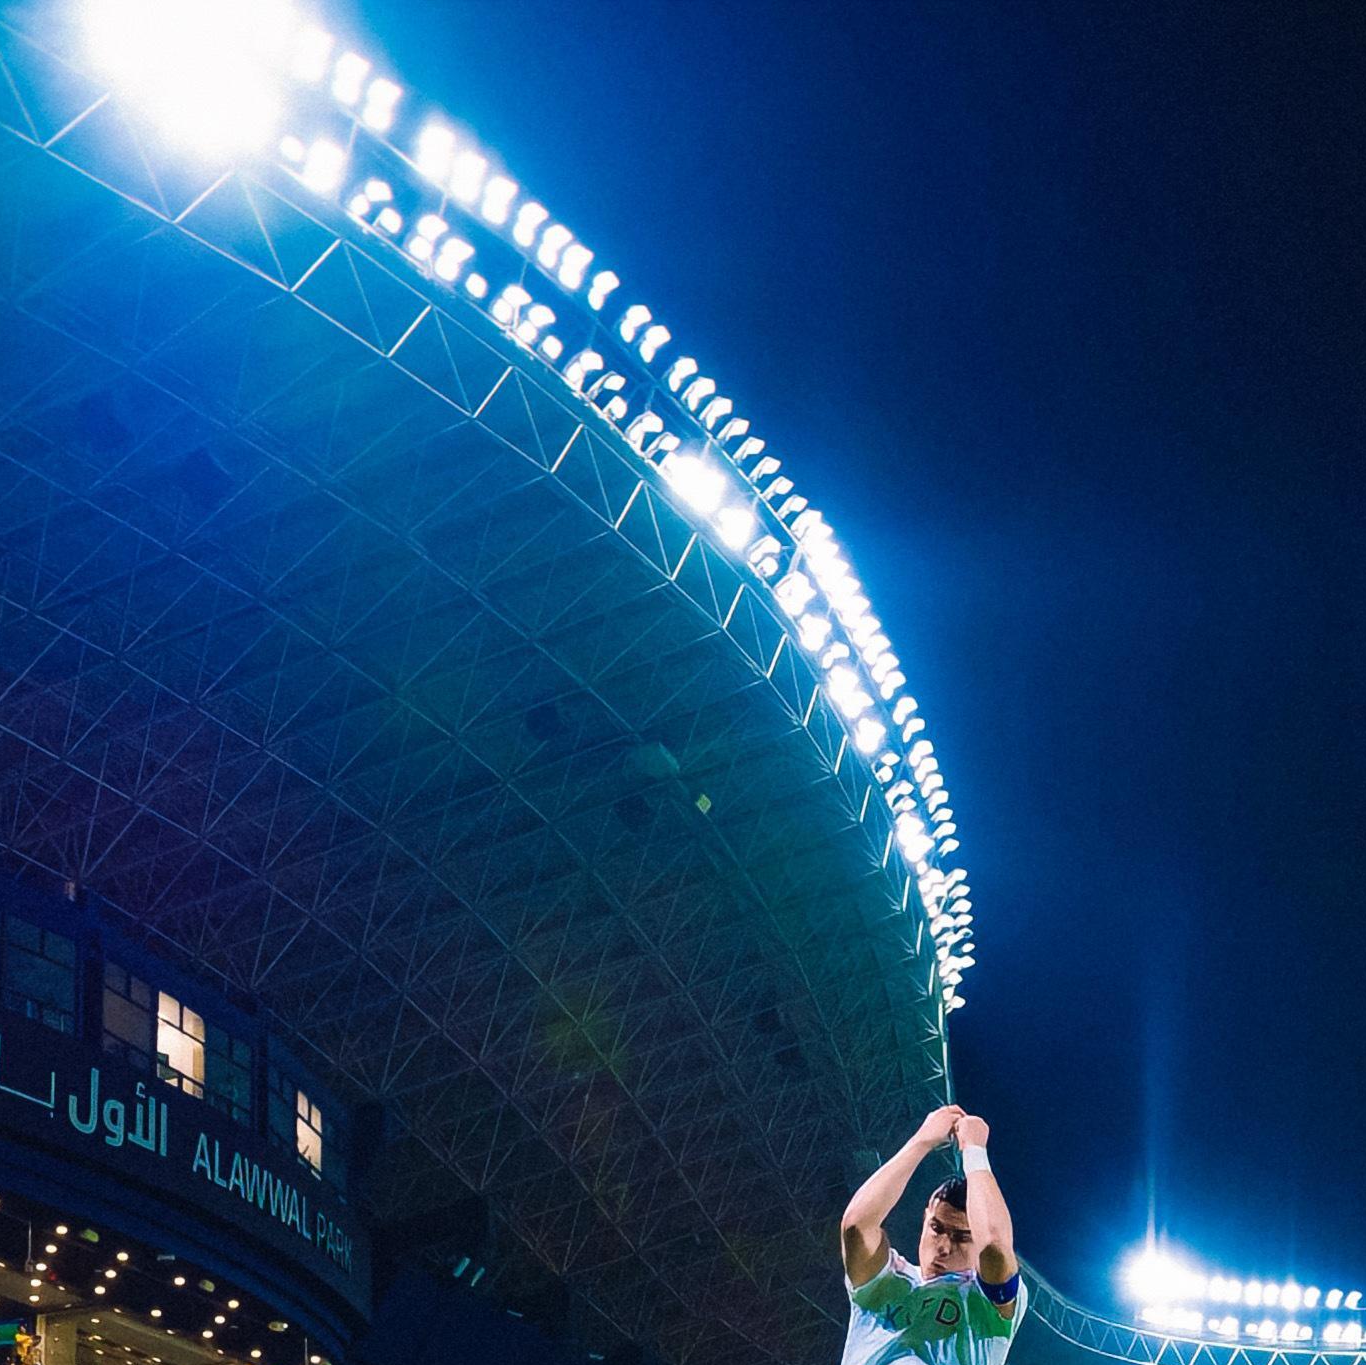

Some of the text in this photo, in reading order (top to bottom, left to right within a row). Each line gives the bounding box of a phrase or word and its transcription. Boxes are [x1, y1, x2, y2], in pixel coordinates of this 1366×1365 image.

[68, 1067, 168, 1157] الأول
[192, 1132, 352, 1275] ALAWWAL PARK
